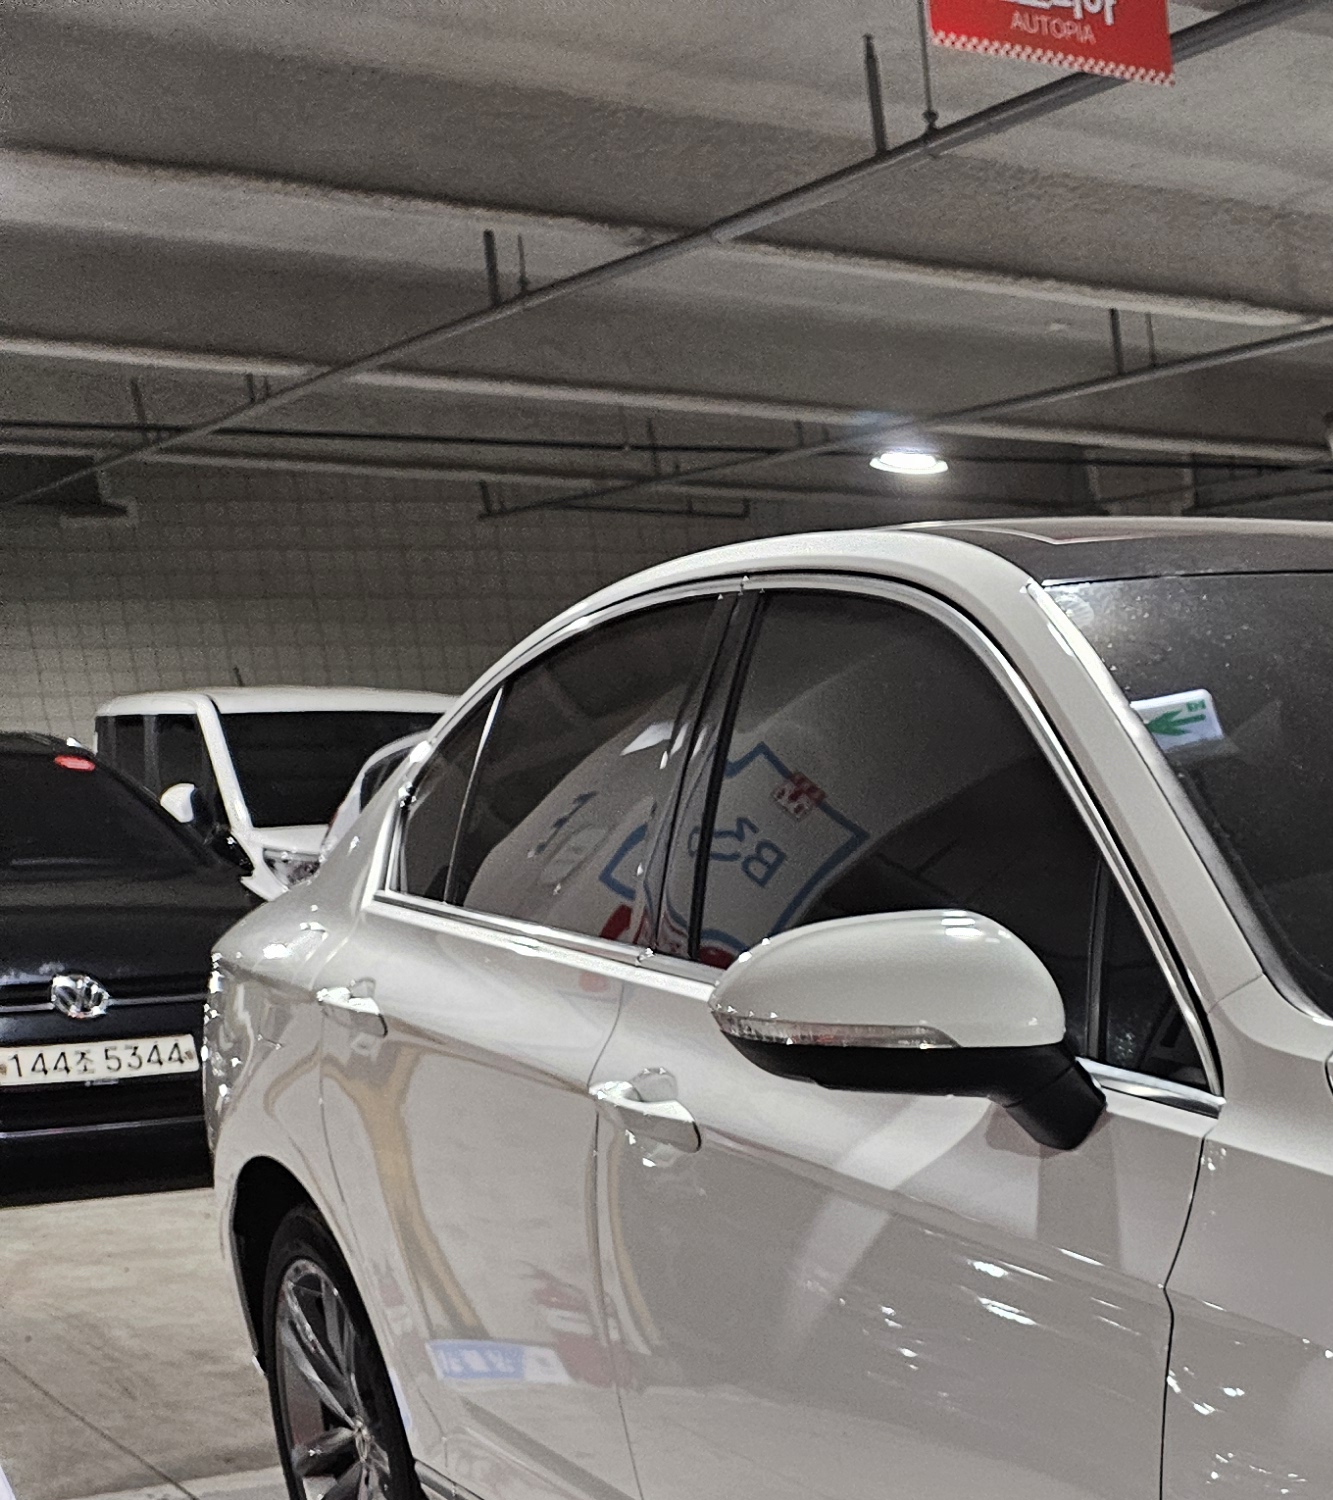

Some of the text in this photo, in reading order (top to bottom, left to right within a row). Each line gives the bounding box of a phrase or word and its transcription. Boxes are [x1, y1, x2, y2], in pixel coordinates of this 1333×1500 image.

[1010, 10, 1096, 45] AUTOPIA
[8, 1039, 186, 1078] 144조 5344
